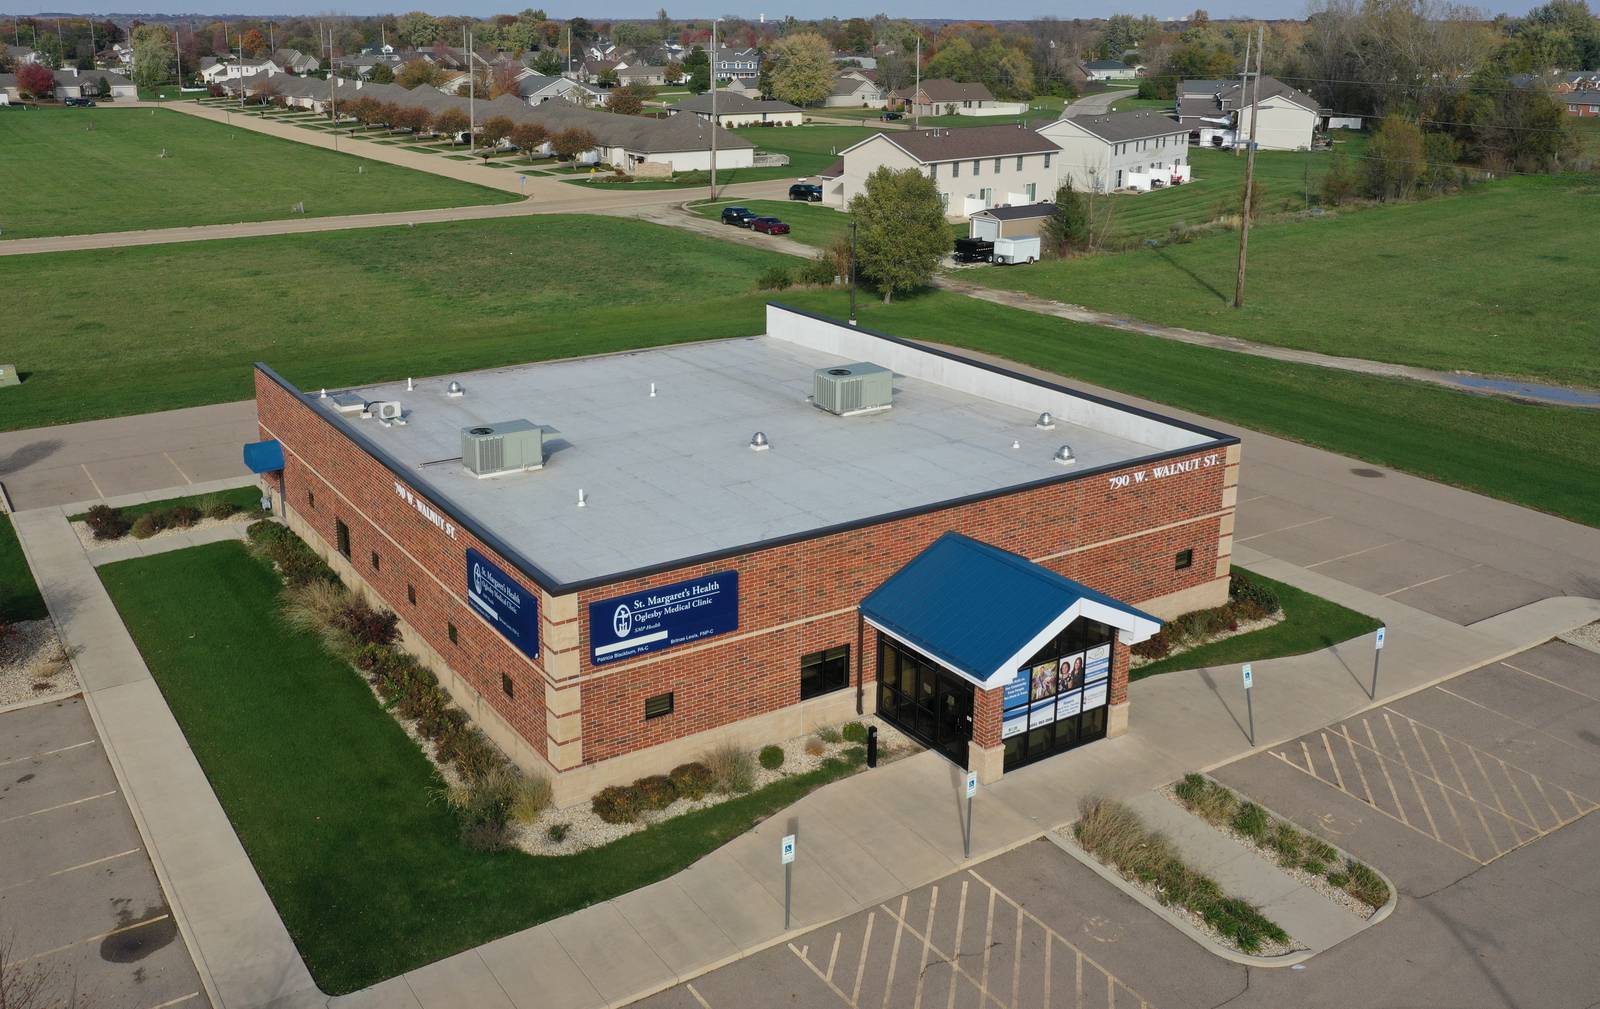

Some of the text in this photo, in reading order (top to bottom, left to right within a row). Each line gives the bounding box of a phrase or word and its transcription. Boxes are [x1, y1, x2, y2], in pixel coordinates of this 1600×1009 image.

[1109, 454, 1220, 490] 790 W. WALNUT ST.
[415, 499, 445, 531] WALNUT
[446, 522, 457, 541] ST.
[506, 586, 520, 605] Health
[634, 581, 720, 609] St. Margaret's Health
[634, 597, 713, 622] Oglesby Medical Clinic
